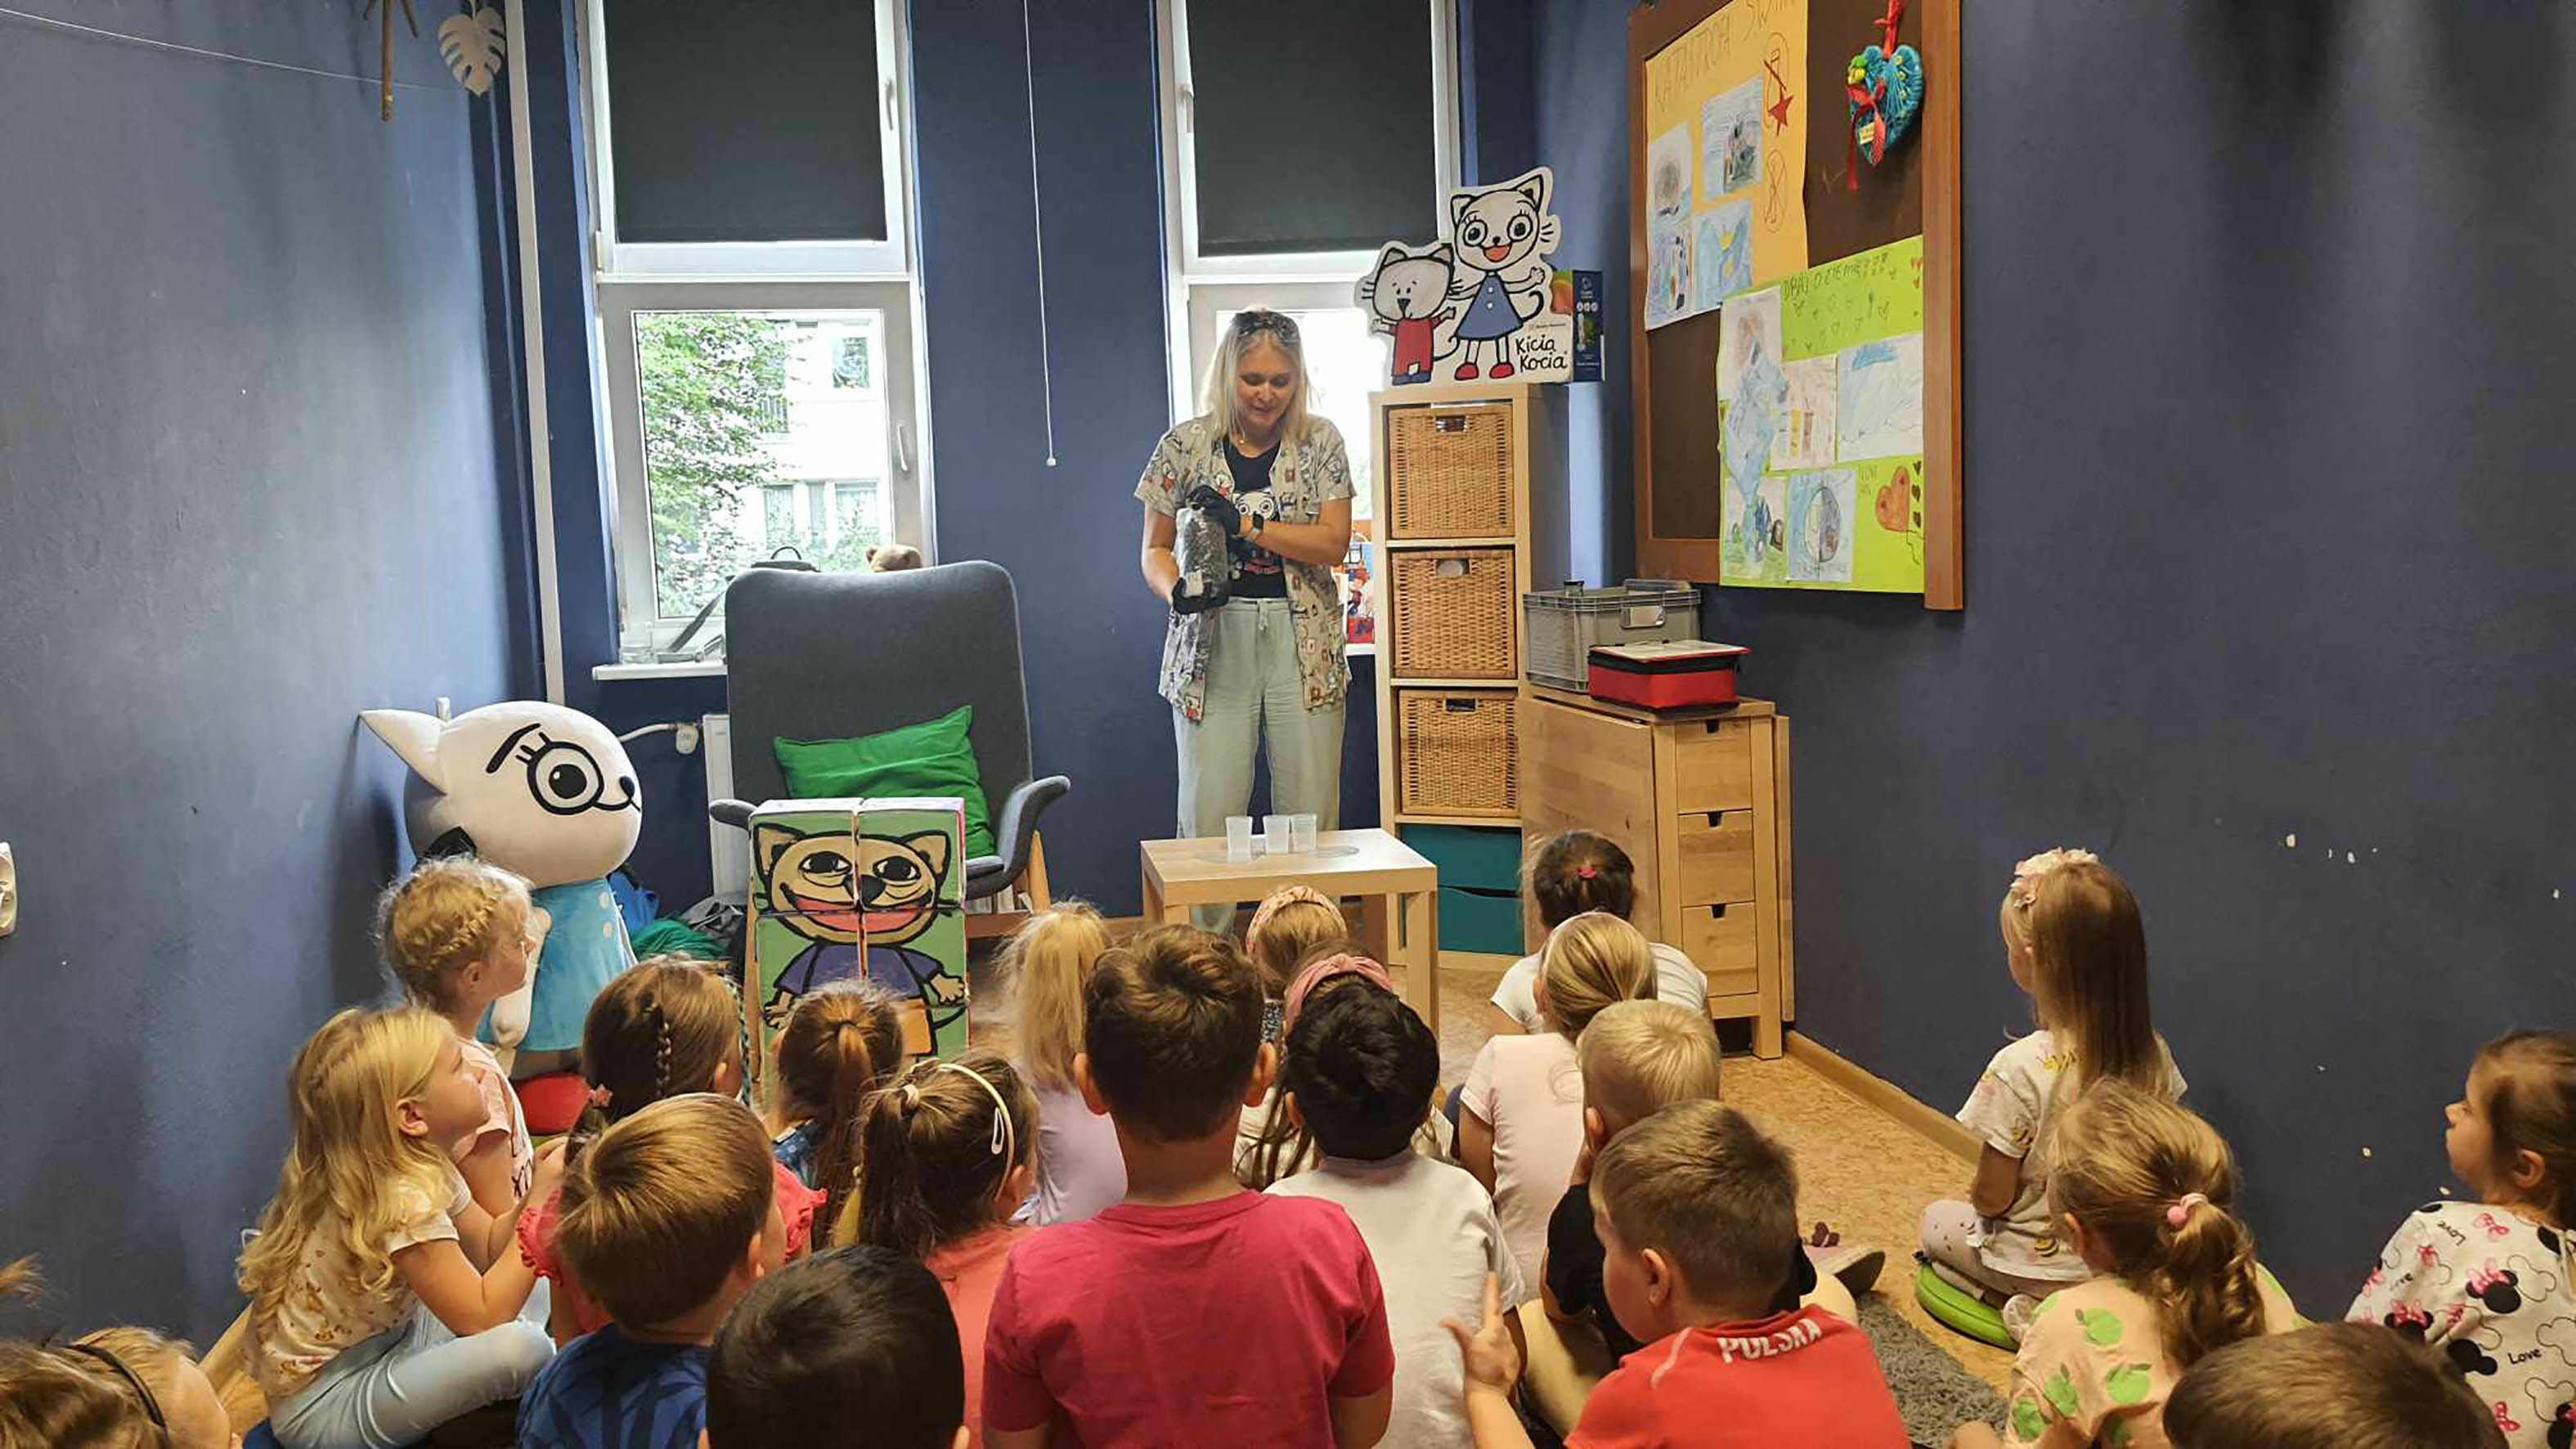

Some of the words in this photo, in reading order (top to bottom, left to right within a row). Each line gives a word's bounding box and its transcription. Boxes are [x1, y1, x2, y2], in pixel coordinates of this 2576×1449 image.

[1515, 334, 1556, 355] Kicia
[1519, 352, 1568, 373] Kocia
[2436, 1220, 2466, 1246] Love
[2507, 1348, 2542, 1365] Love
